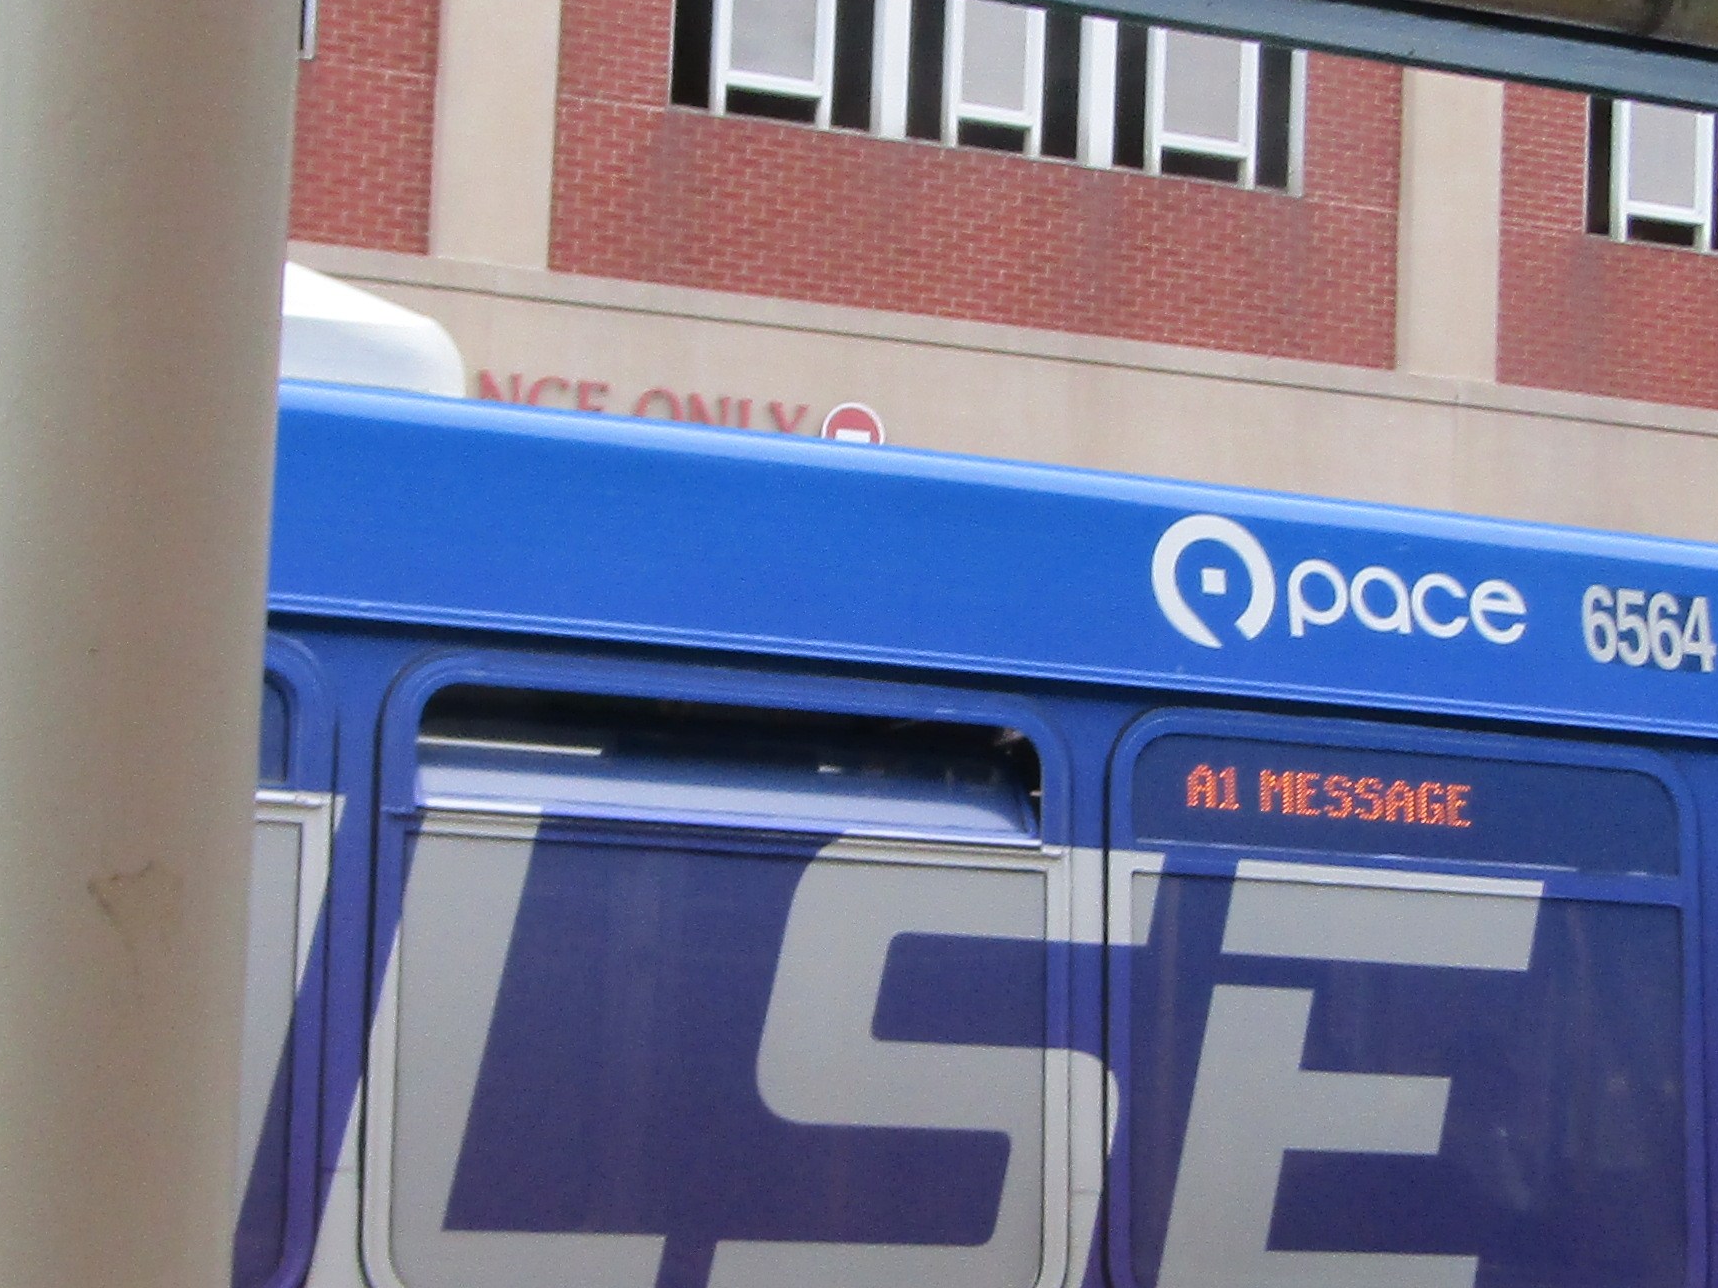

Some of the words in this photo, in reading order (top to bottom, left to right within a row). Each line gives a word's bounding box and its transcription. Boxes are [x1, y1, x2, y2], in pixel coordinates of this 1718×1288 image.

[1287, 558, 1527, 645] pace
[1582, 583, 1717, 674] 6564
[1186, 762, 1240, 811] A1
[1259, 767, 1473, 829] MESSAGE
